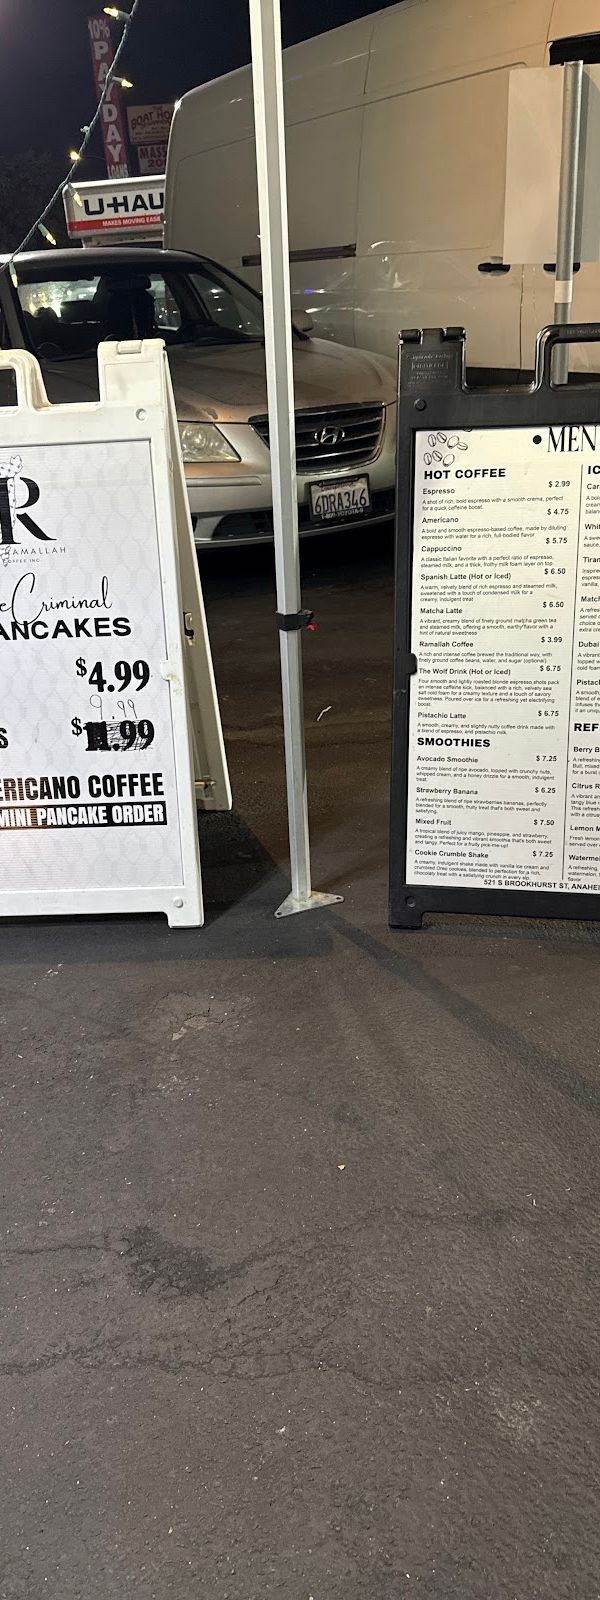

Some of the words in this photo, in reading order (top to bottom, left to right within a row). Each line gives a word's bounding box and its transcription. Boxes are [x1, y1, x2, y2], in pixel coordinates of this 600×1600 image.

[94, 41, 122, 162] PAYDAY
[131, 112, 154, 130] BOAT
[156, 110, 171, 120] HO
[140, 146, 167, 160] MASS
[83, 192, 164, 215] U-HAU
[123, 217, 145, 225] MOVING
[548, 425, 598, 452] MEN
[424, 470, 450, 480] HOT
[455, 468, 506, 478] COFFEE
[588, 465, 600, 474] IC
[315, 488, 366, 514] 6DRA346
[12, 572, 112, 625] Criminal
[0, 617, 131, 640] ANCAKES
[76, 657, 149, 692] $4.99
[574, 723, 599, 732] REF
[418, 738, 490, 747] SMOOTHIES
[0, 776, 80, 801] RICANO
[88, 773, 164, 798] COFFEE
[416, 787, 451, 795] Strawberry
[37, 806, 108, 825] PANCAKE
[112, 804, 164, 823] ORDER
[505, 880, 557, 888] BROOKHURST
